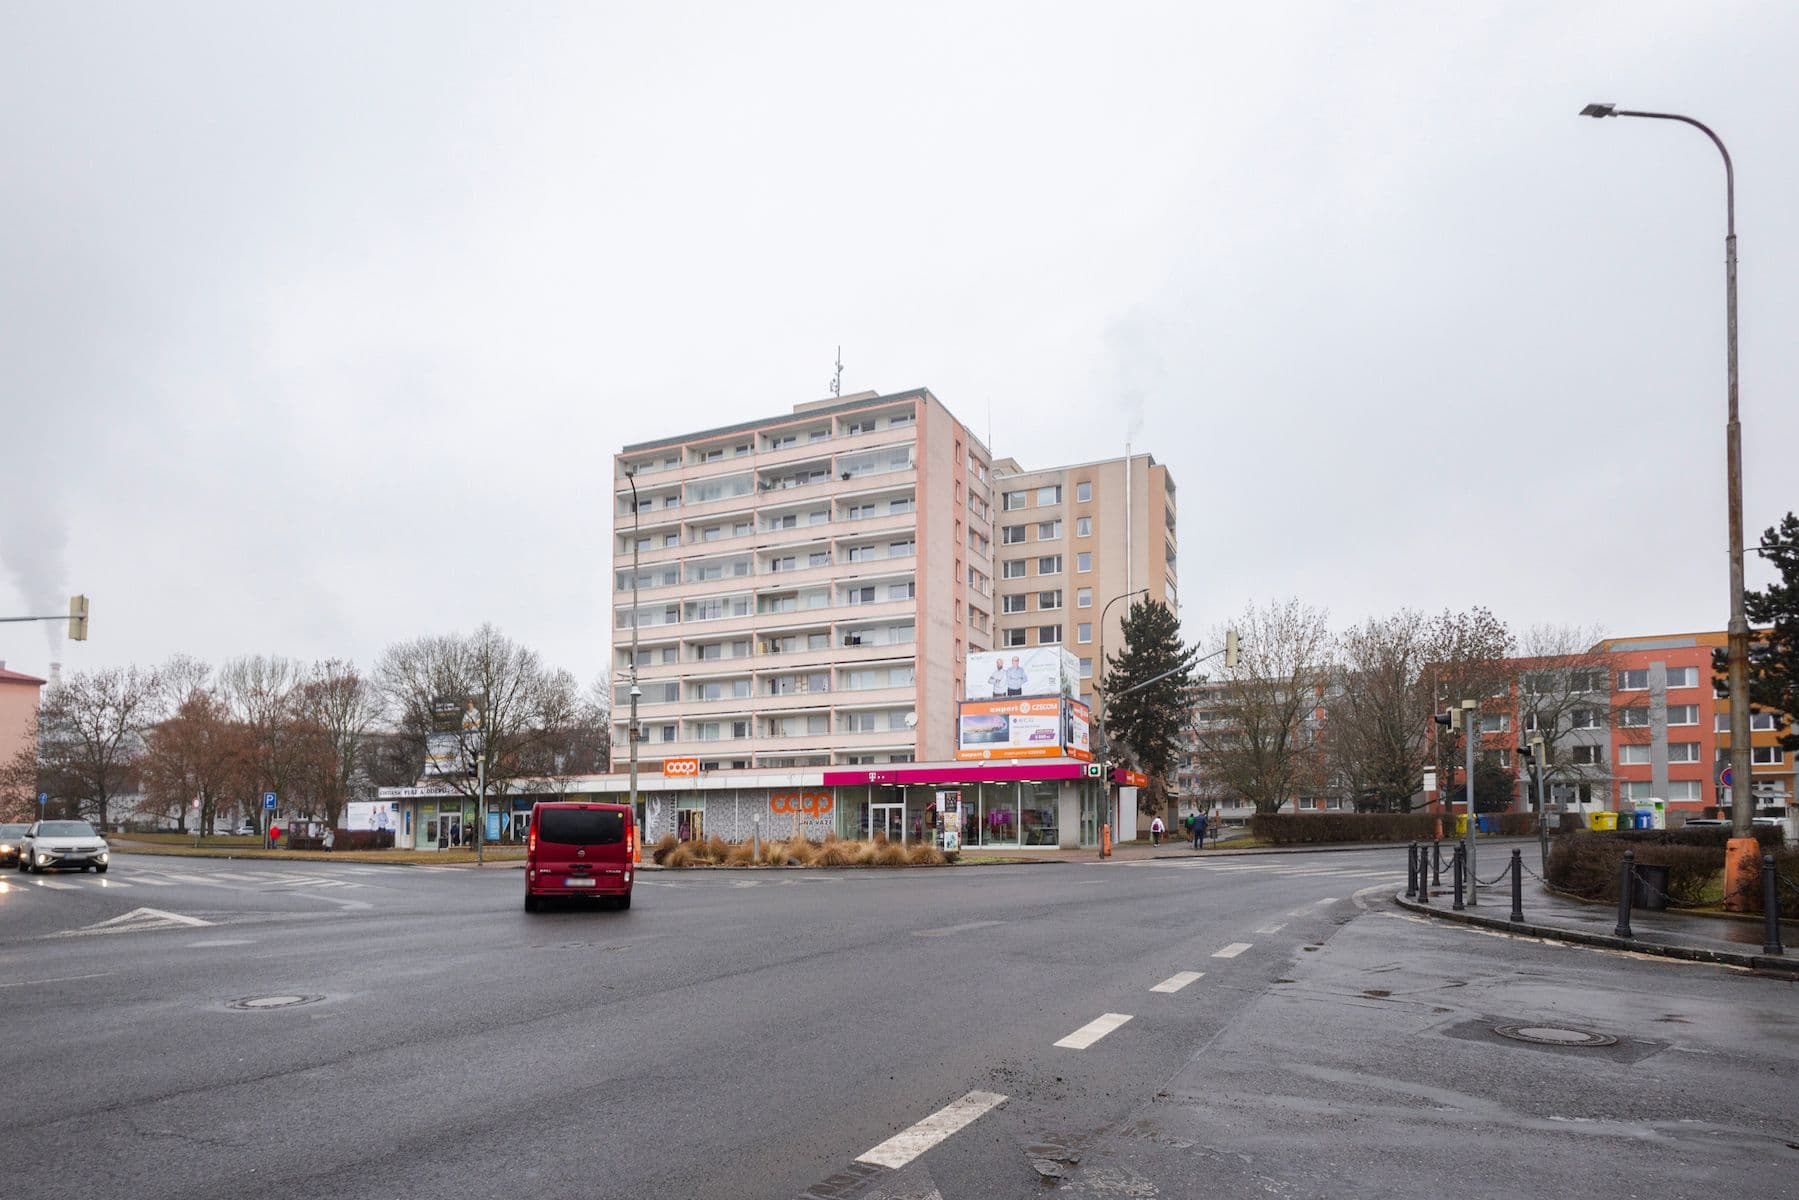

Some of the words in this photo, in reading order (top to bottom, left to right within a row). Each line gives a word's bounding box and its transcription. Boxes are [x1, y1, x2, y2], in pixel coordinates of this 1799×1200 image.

[666, 761, 697, 776] coop
[266, 794, 274, 805] P
[770, 791, 833, 818] coop
